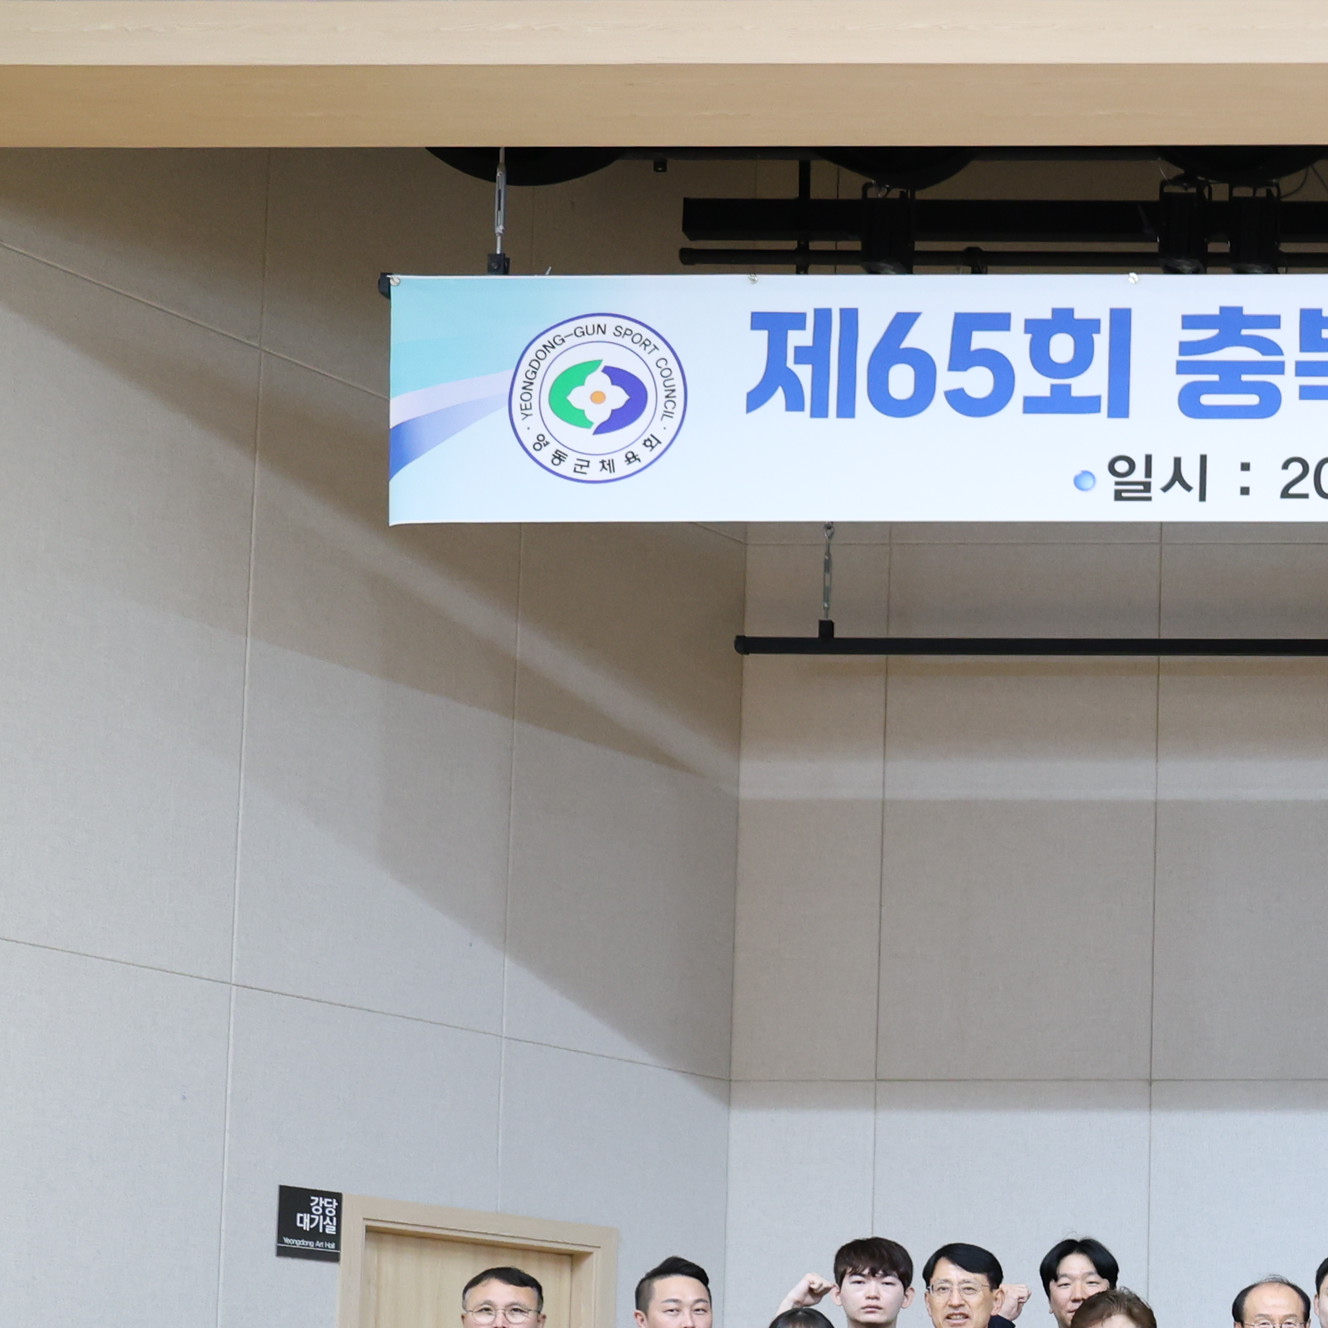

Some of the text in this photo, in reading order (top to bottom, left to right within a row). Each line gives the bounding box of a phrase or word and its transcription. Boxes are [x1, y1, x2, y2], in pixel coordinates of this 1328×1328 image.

[519, 323, 677, 422] YEONGDONG-GUN SPORT COUNCIL
[745, 307, 1132, 419] 제65회
[532, 433, 662, 475] 영동군체육회
[1107, 453, 1208, 503] 일시
[296, 1213, 336, 1234] 대기실
[309, 1195, 338, 1216] 강당
